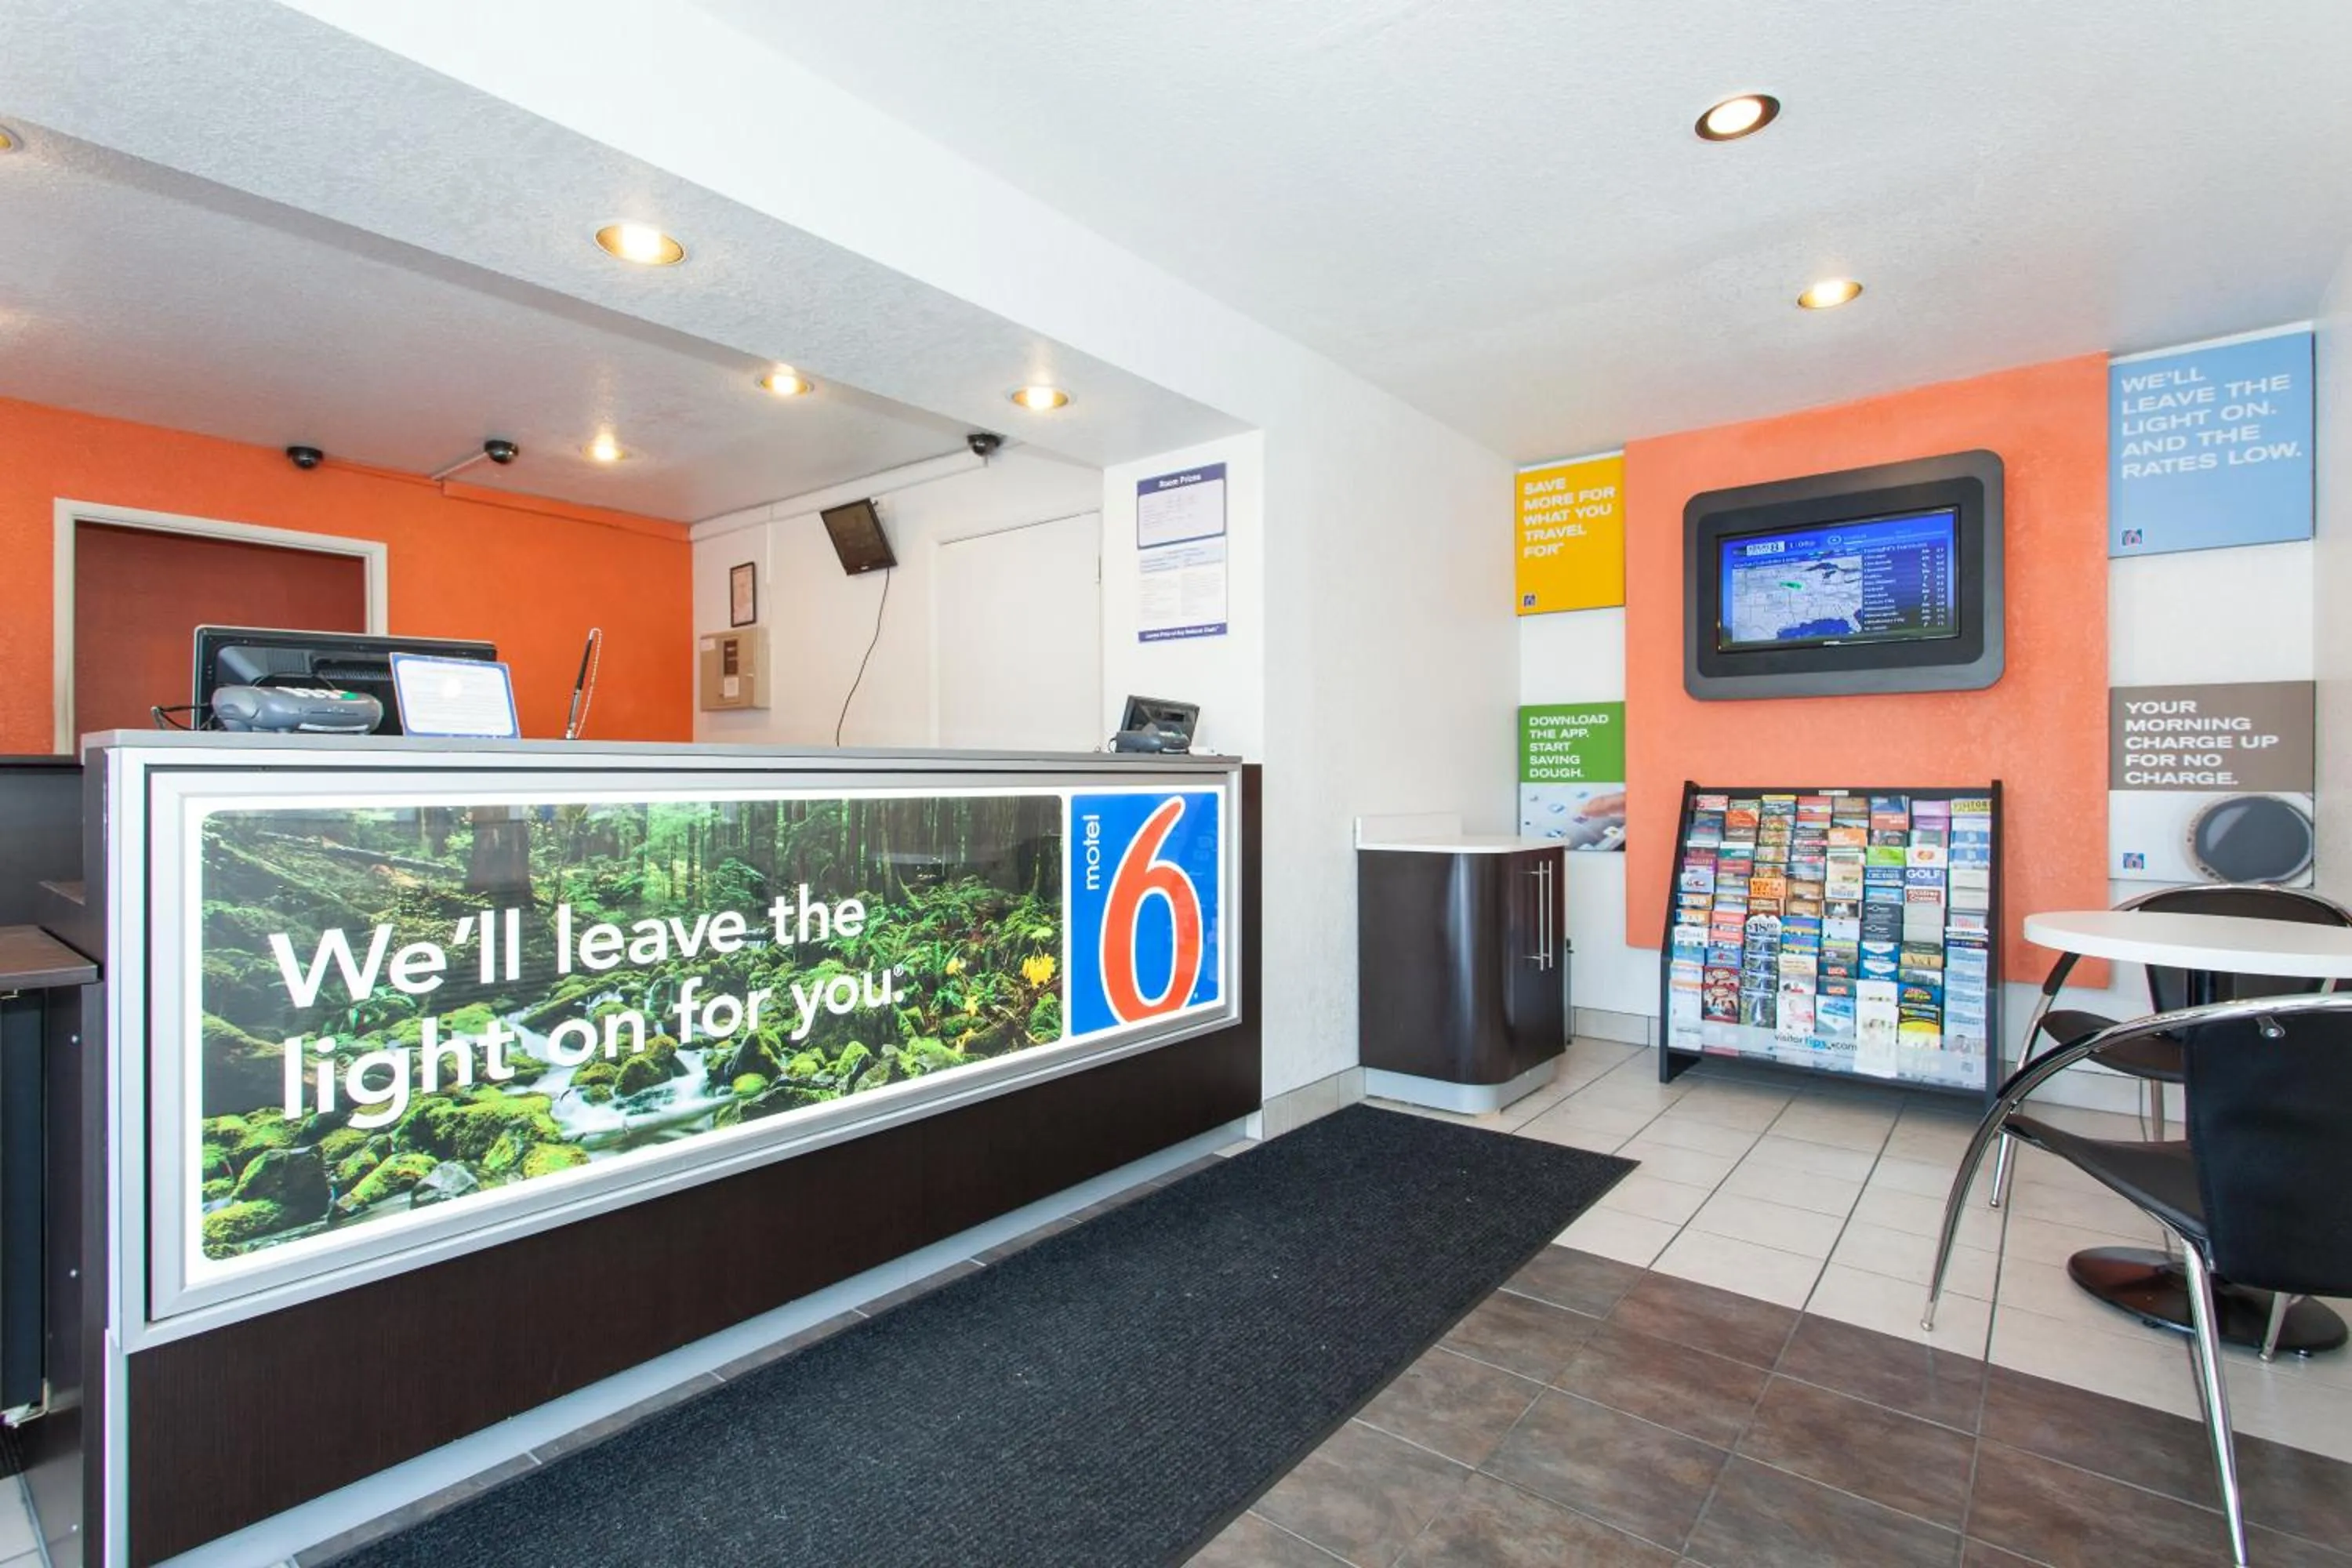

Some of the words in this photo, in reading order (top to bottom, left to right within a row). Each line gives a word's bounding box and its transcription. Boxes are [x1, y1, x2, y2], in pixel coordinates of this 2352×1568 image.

[2122, 367, 2207, 394] WE'LL
[2122, 387, 2216, 416] LEAVE
[2224, 373, 2291, 400] THE
[2122, 408, 2212, 437] LIGHT
[2220, 400, 2278, 422] ON.
[2120, 435, 2188, 459] AND
[2195, 424, 2261, 448] THE
[2122, 452, 2218, 481] RATES
[2228, 441, 2303, 466] LOW.
[1524, 477, 1566, 495] SAVE
[1524, 492, 1574, 511] MORE
[1579, 486, 1616, 503] FOR
[1523, 510, 1570, 527] WHAT
[1575, 503, 1613, 519] YOU
[1523, 523, 1587, 543] TRAVEL
[2125, 700, 2198, 714] YOUR
[1530, 714, 1610, 727] DOWNLOAD
[2125, 717, 2252, 732] MORNING
[1530, 729, 1556, 739] THE
[1559, 728, 1589, 739] APP.
[2125, 735, 2234, 750] CHARGE
[2240, 735, 2279, 749] UP
[1530, 742, 1571, 753] START
[1530, 755, 1581, 765] SAVING
[2125, 753, 2177, 768] FOR
[2183, 753, 2223, 768] NO
[1530, 768, 1584, 779] DOUGH.
[2125, 771, 2239, 786] CHARGE.
[1081, 815, 1101, 891] motel
[1906, 869, 1941, 879] GOLF
[1098, 796, 1204, 1025] 6
[267, 907, 521, 1009] We'll
[557, 903, 746, 975] leave
[768, 884, 866, 947] the
[284, 1016, 516, 1130] light
[547, 1006, 646, 1068] on
[672, 975, 771, 1044] for
